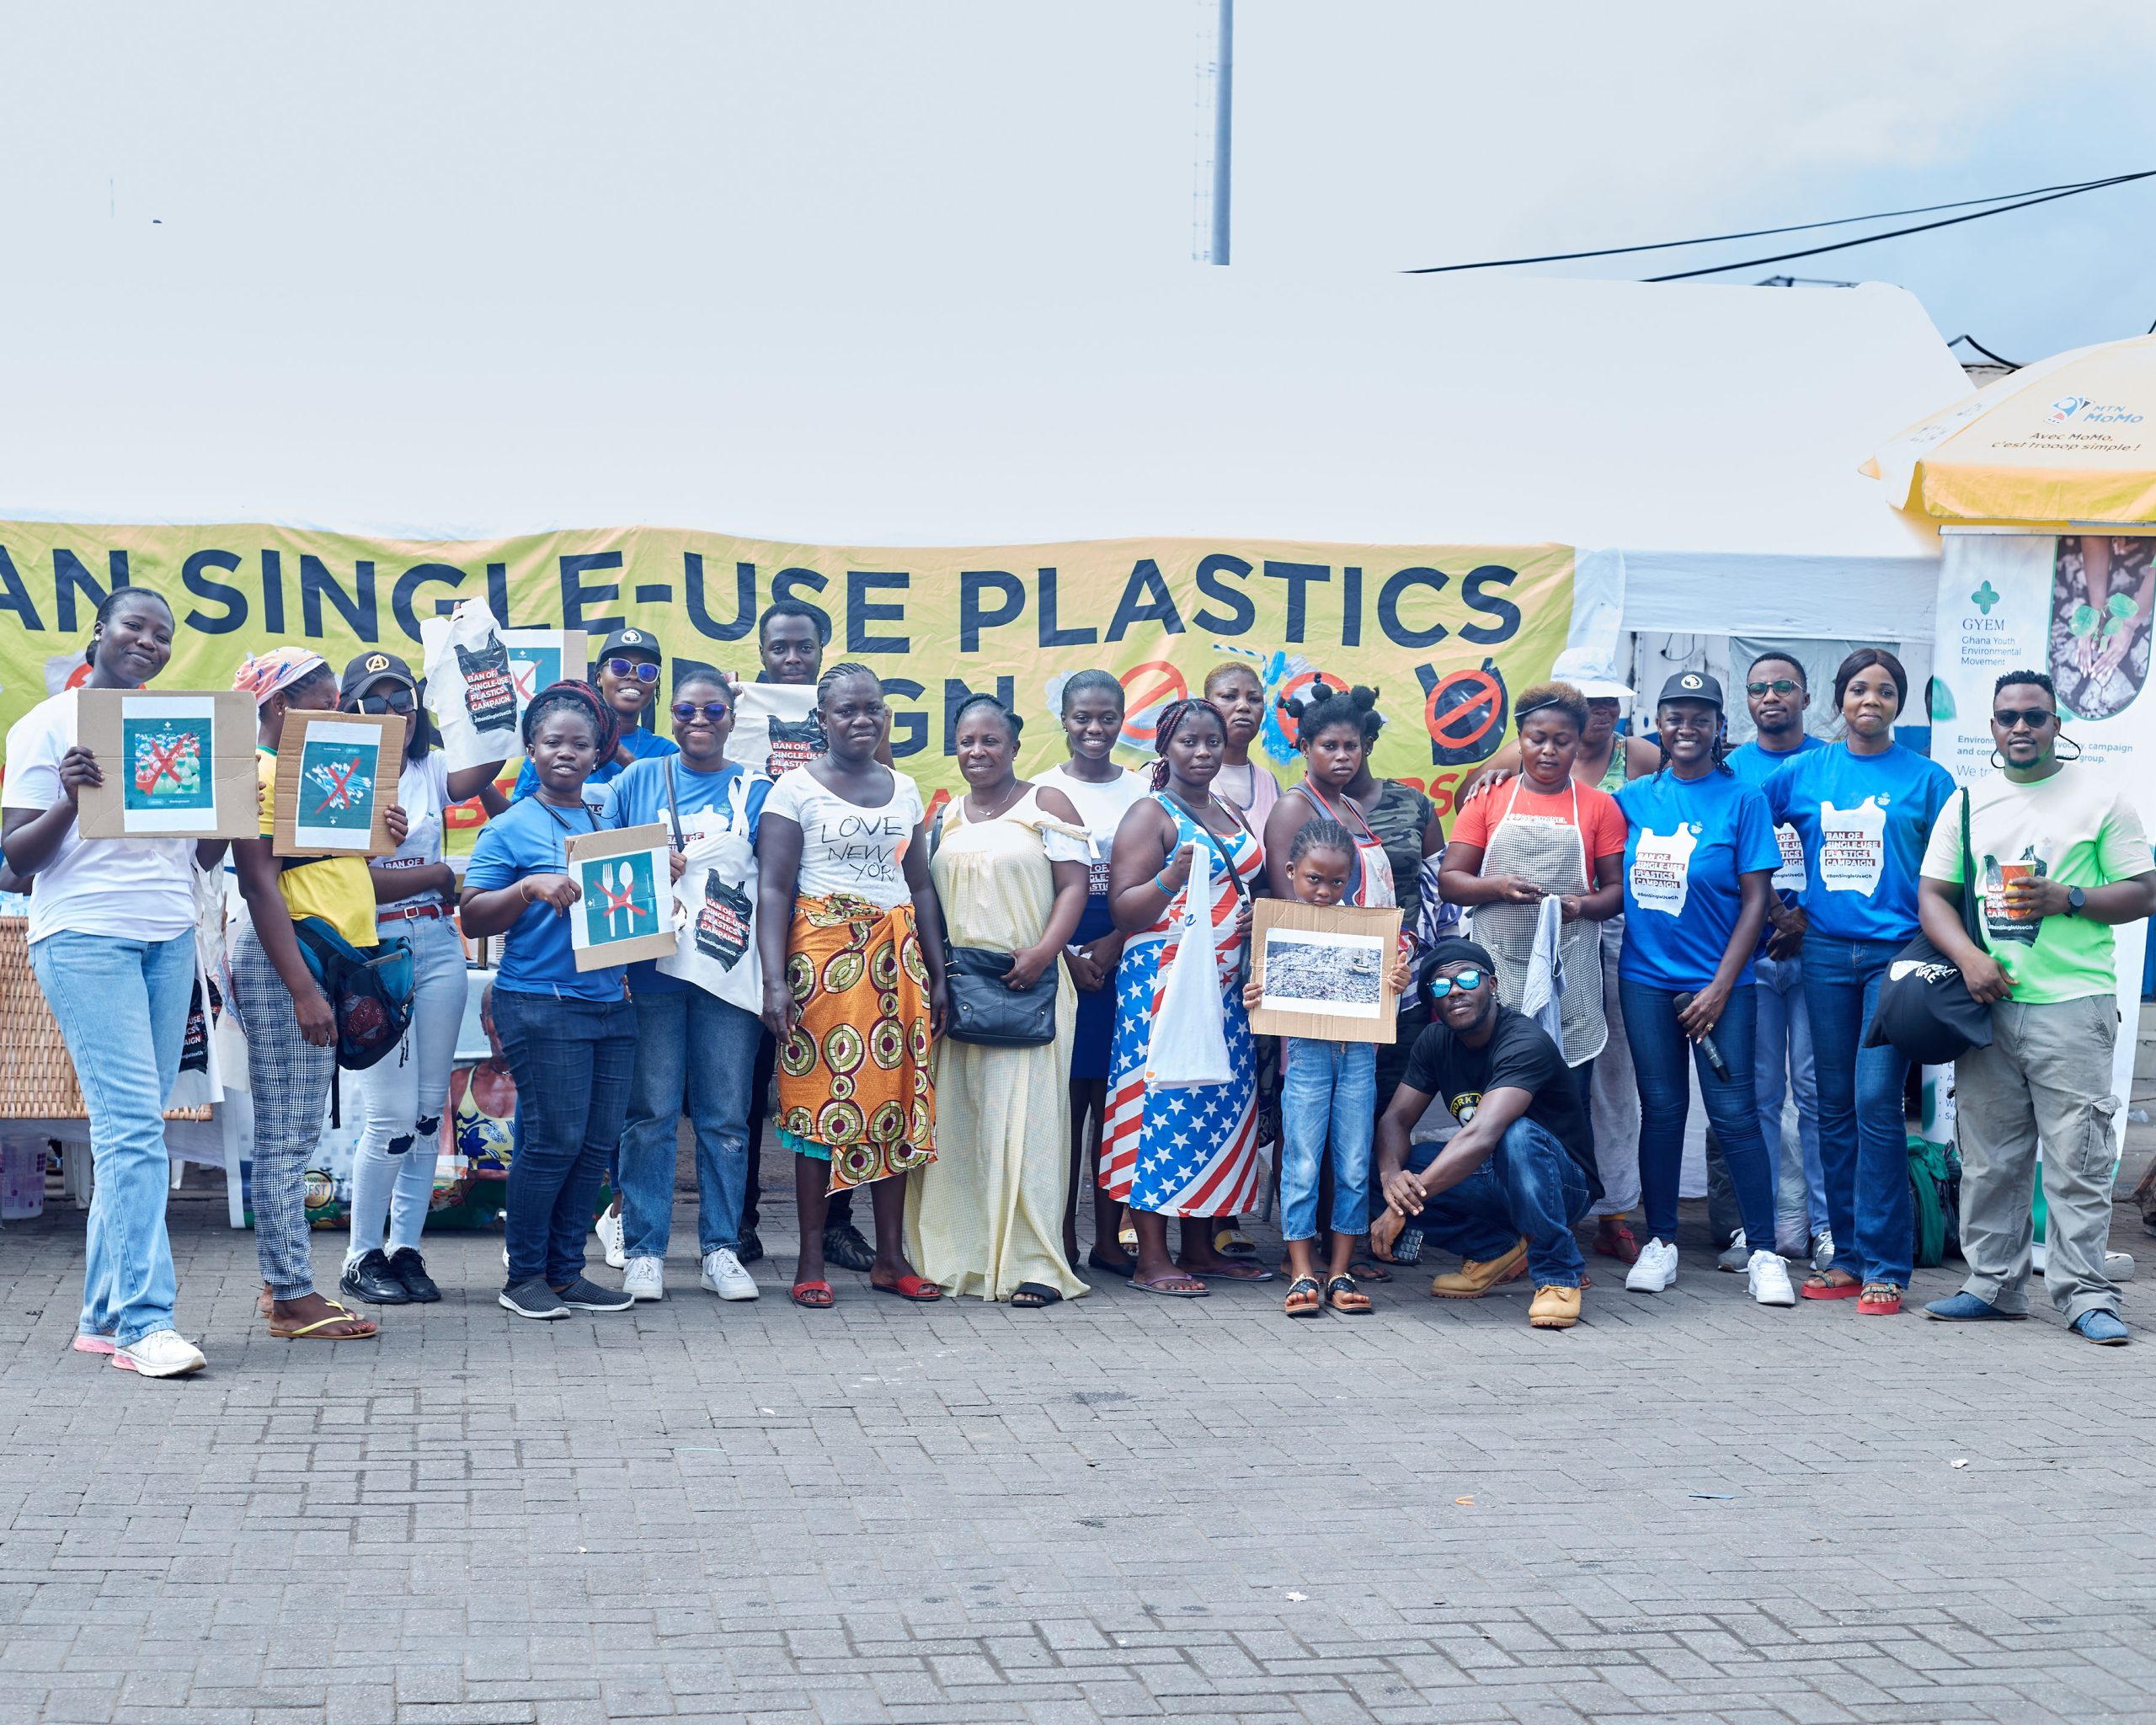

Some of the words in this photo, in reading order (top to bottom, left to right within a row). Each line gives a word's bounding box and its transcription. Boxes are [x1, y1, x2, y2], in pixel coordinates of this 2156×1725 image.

[2083, 413, 2144, 424] MoMo
[2030, 432, 2066, 441] Avec
[2067, 433, 2114, 442] MoMo,
[2082, 443, 2132, 452] simple
[960, 553, 1522, 653] PLASTICS
[1962, 618, 2004, 631] GYEM
[1961, 636, 1991, 644] Ghana
[1993, 637, 2015, 645] Youth
[1961, 646, 2021, 656] Environmental
[1961, 657, 2005, 665] Movement
[467, 674, 485, 683] BAN
[486, 670, 496, 679] OF
[469, 676, 510, 692] SINGLE-USE
[470, 686, 504, 702] PLASTICS
[472, 696, 510, 711] CAMPAIGN
[773, 742, 792, 750] BAN
[2089, 743, 2132, 753] campaign
[1956, 765, 1977, 777] We
[821, 815, 905, 843] LOVE
[829, 842, 895, 863] NEW
[385, 860, 405, 869] BAN
[408, 858, 422, 868] OF
[1636, 879, 1678, 889] CAMPAIGN
[707, 898, 721, 910] BAN
[723, 907, 734, 916] OF
[703, 914, 739, 936] PLASTICS
[705, 906, 747, 931] SINGLE-USE
[701, 923, 740, 946] CAMPAIGN
